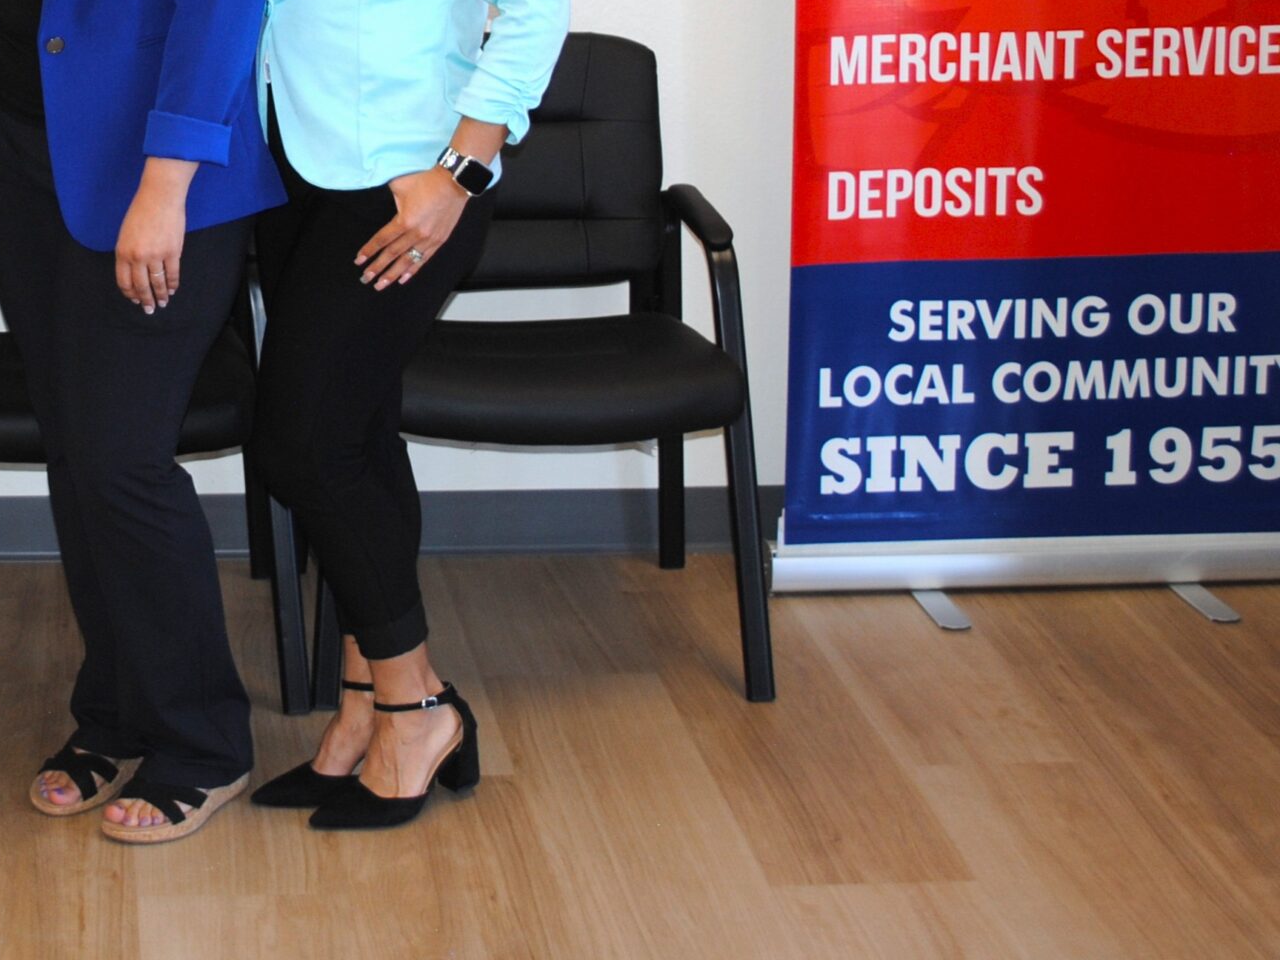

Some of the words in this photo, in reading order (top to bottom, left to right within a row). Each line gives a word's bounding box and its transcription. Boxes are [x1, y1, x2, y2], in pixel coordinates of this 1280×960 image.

[830, 30, 1084, 86] MERCHANT
[827, 166, 1045, 221] DEPOSITS
[888, 295, 1110, 342] SERVING
[1127, 293, 1237, 336] OUR
[819, 364, 975, 408] LOCAL
[992, 354, 1280, 404] COMMUNIT
[820, 430, 1074, 496] SINCE
[1104, 424, 1280, 487] 1955
